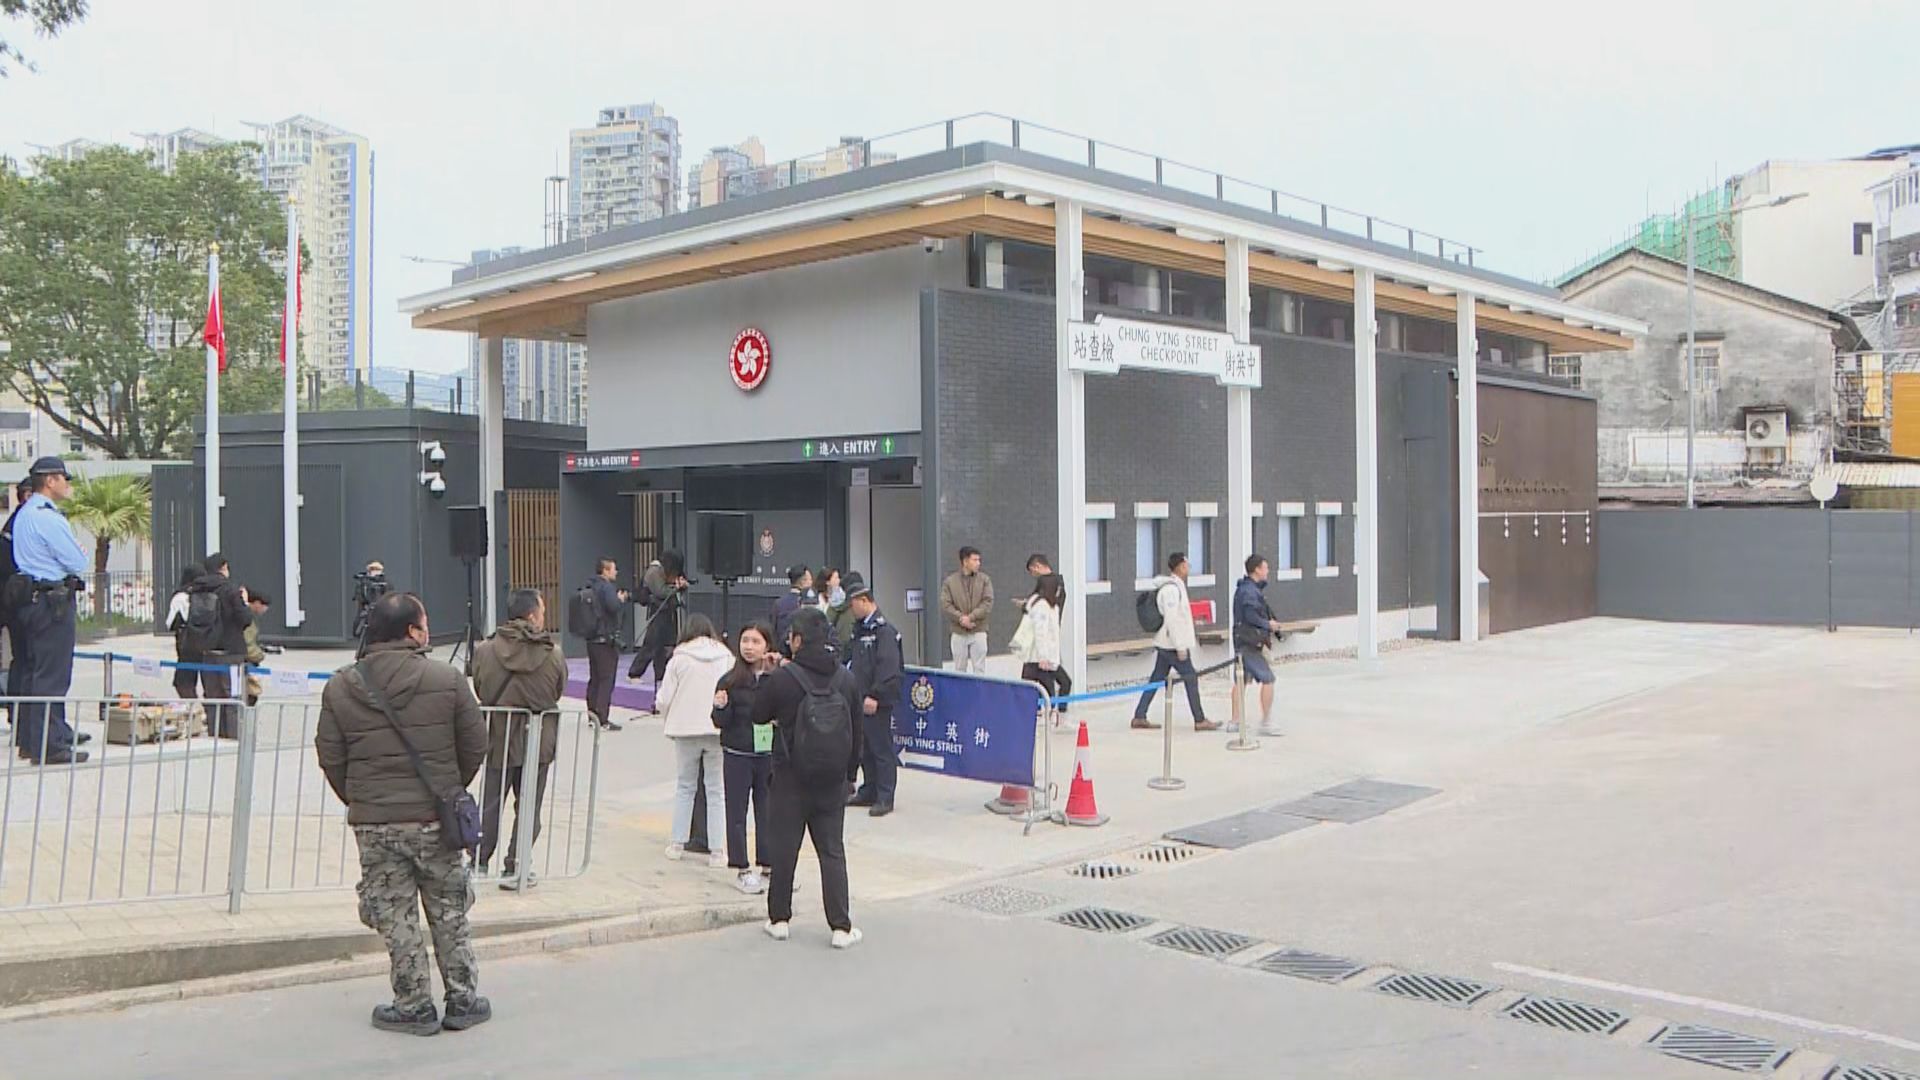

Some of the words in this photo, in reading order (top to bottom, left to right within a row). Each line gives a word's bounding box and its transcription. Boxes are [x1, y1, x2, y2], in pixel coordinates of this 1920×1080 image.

[1118, 326, 1150, 344] CHUNG
[1156, 330, 1180, 347] YING
[1185, 334, 1219, 352] STREET
[1140, 345, 1200, 366] CHECKPOINT
[843, 439, 878, 455] ENTRY
[601, 455, 610, 466] NO
[610, 455, 629, 466] ENTRY
[914, 737, 935, 750] YING
[936, 741, 963, 755] STREET
